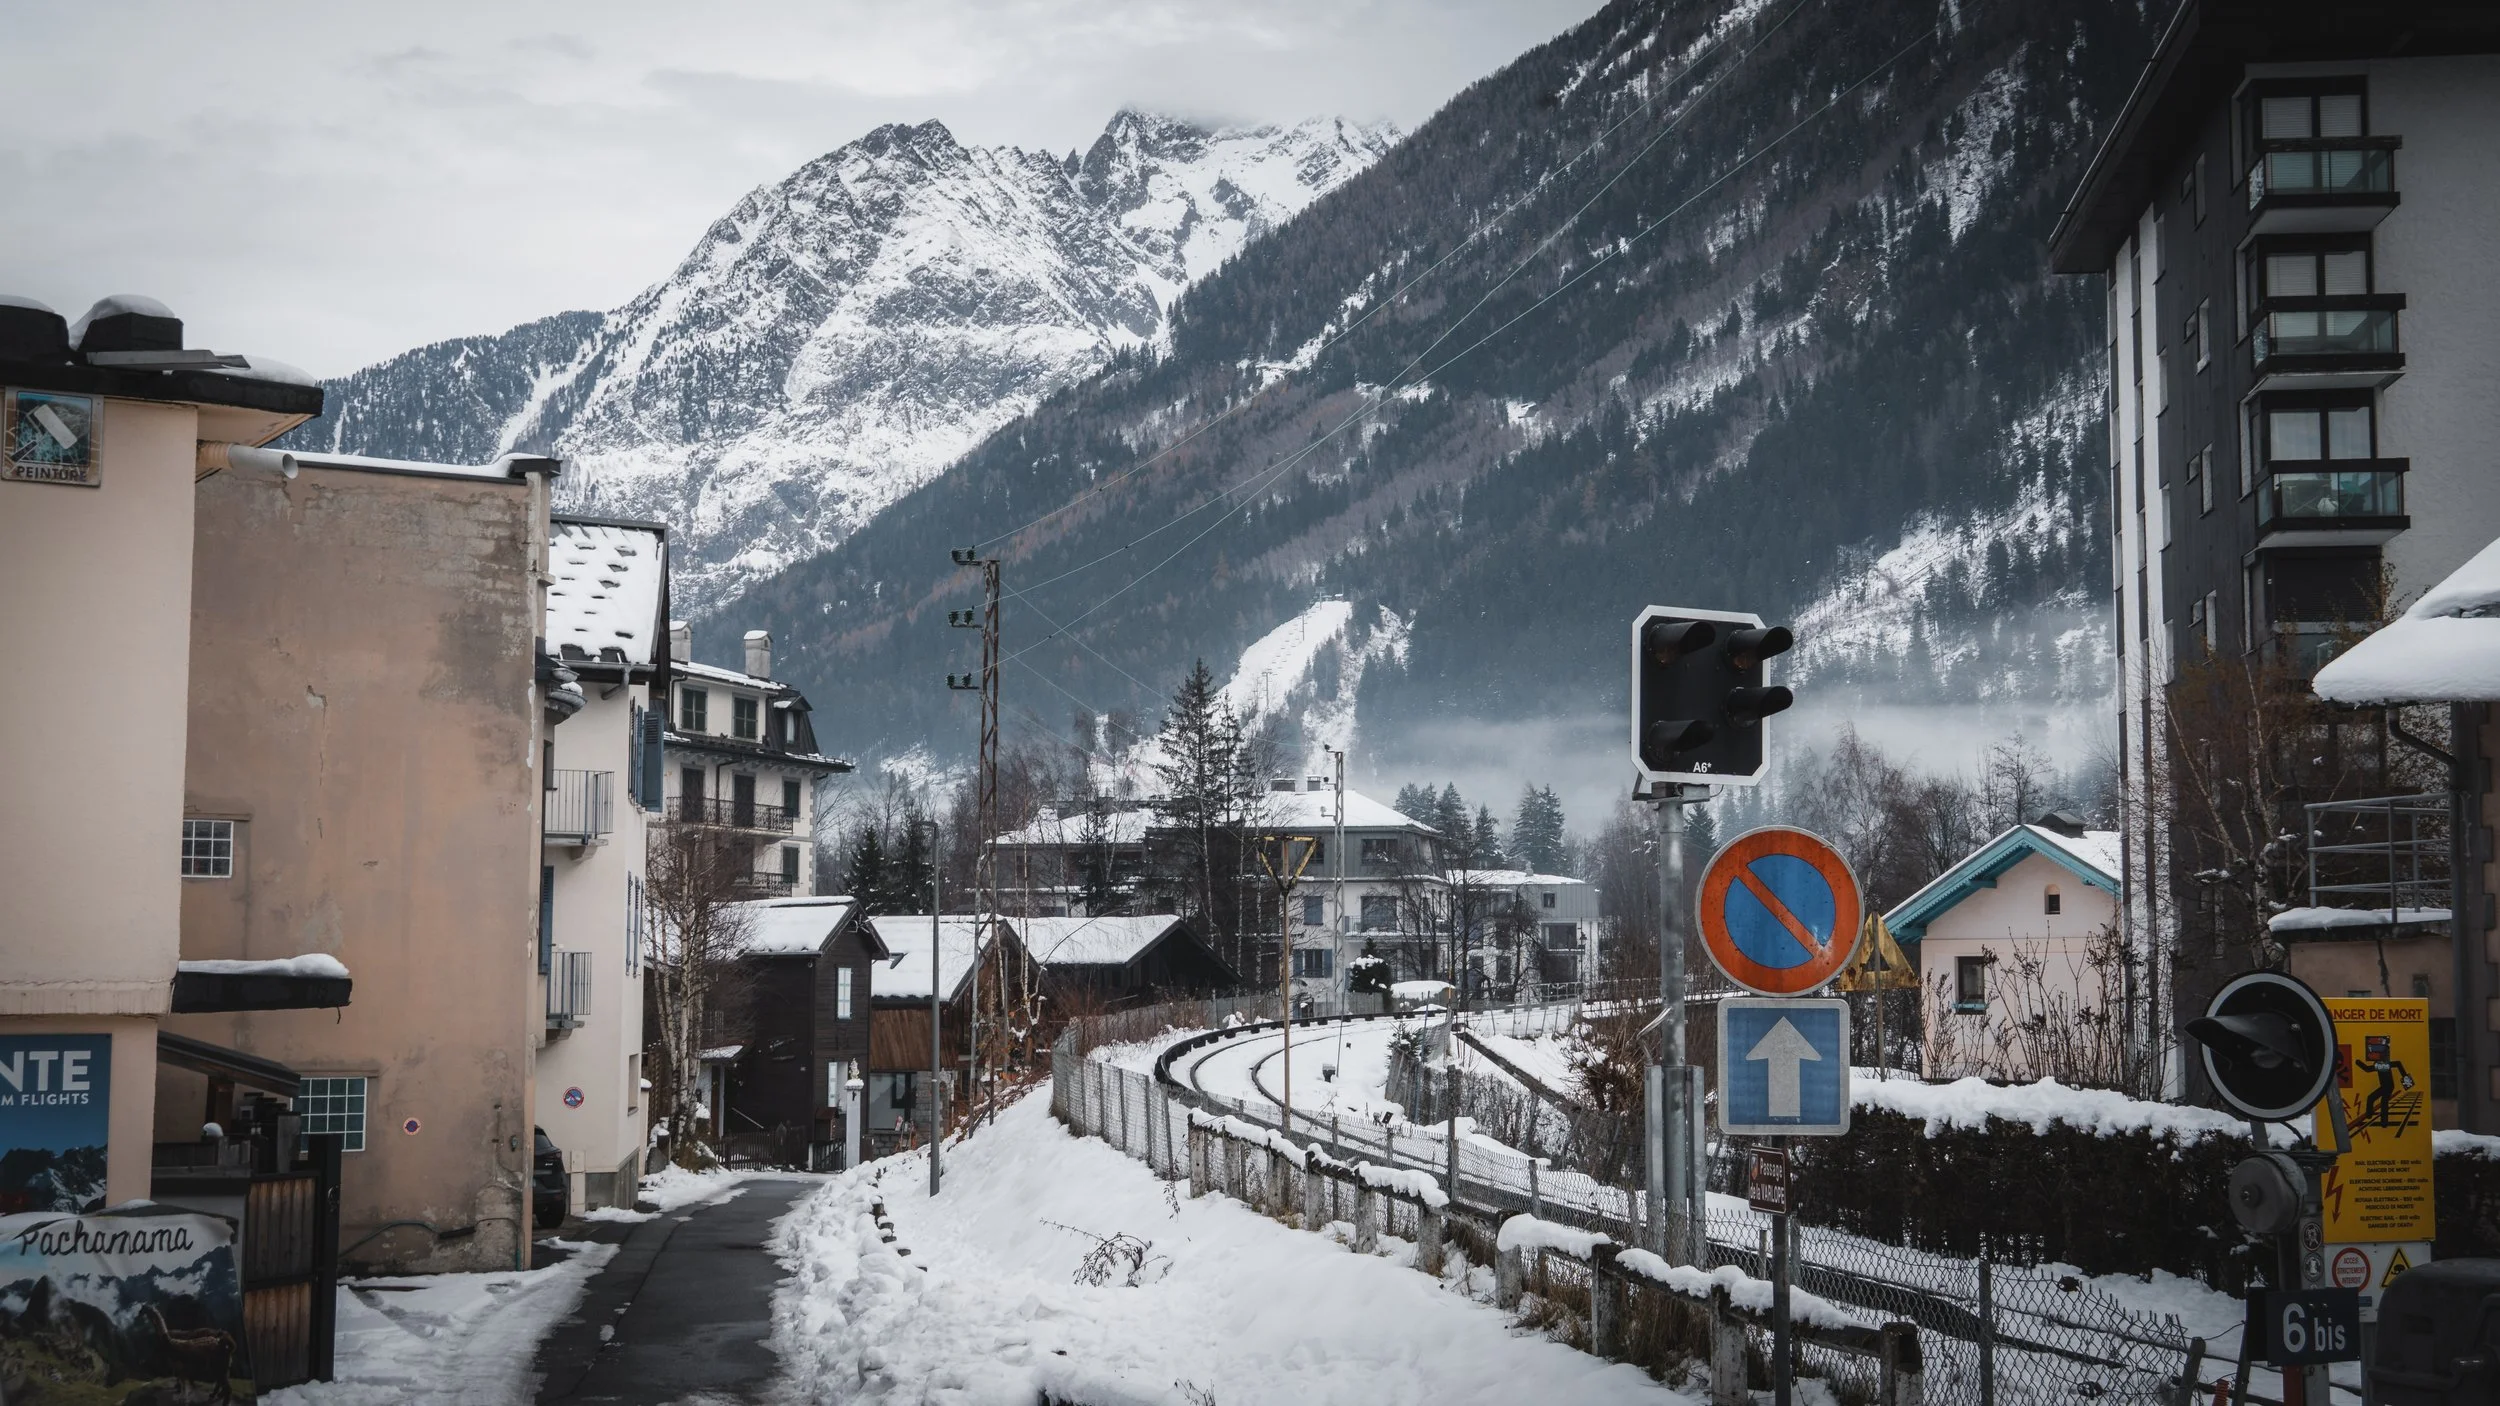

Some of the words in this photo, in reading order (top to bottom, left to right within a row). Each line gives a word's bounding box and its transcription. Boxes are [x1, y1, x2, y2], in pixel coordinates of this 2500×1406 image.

[16, 466, 88, 482] PEINTURE
[2369, 1009, 2385, 1019] DE
[2388, 1009, 2423, 1019] MORT
[21, 1093, 89, 1106] FLIGHTS
[1760, 1157, 1782, 1182] Passage
[19, 1219, 194, 1256] Pachamama
[2283, 1302, 2306, 1353] 6
[2314, 1317, 2346, 1351] bis
